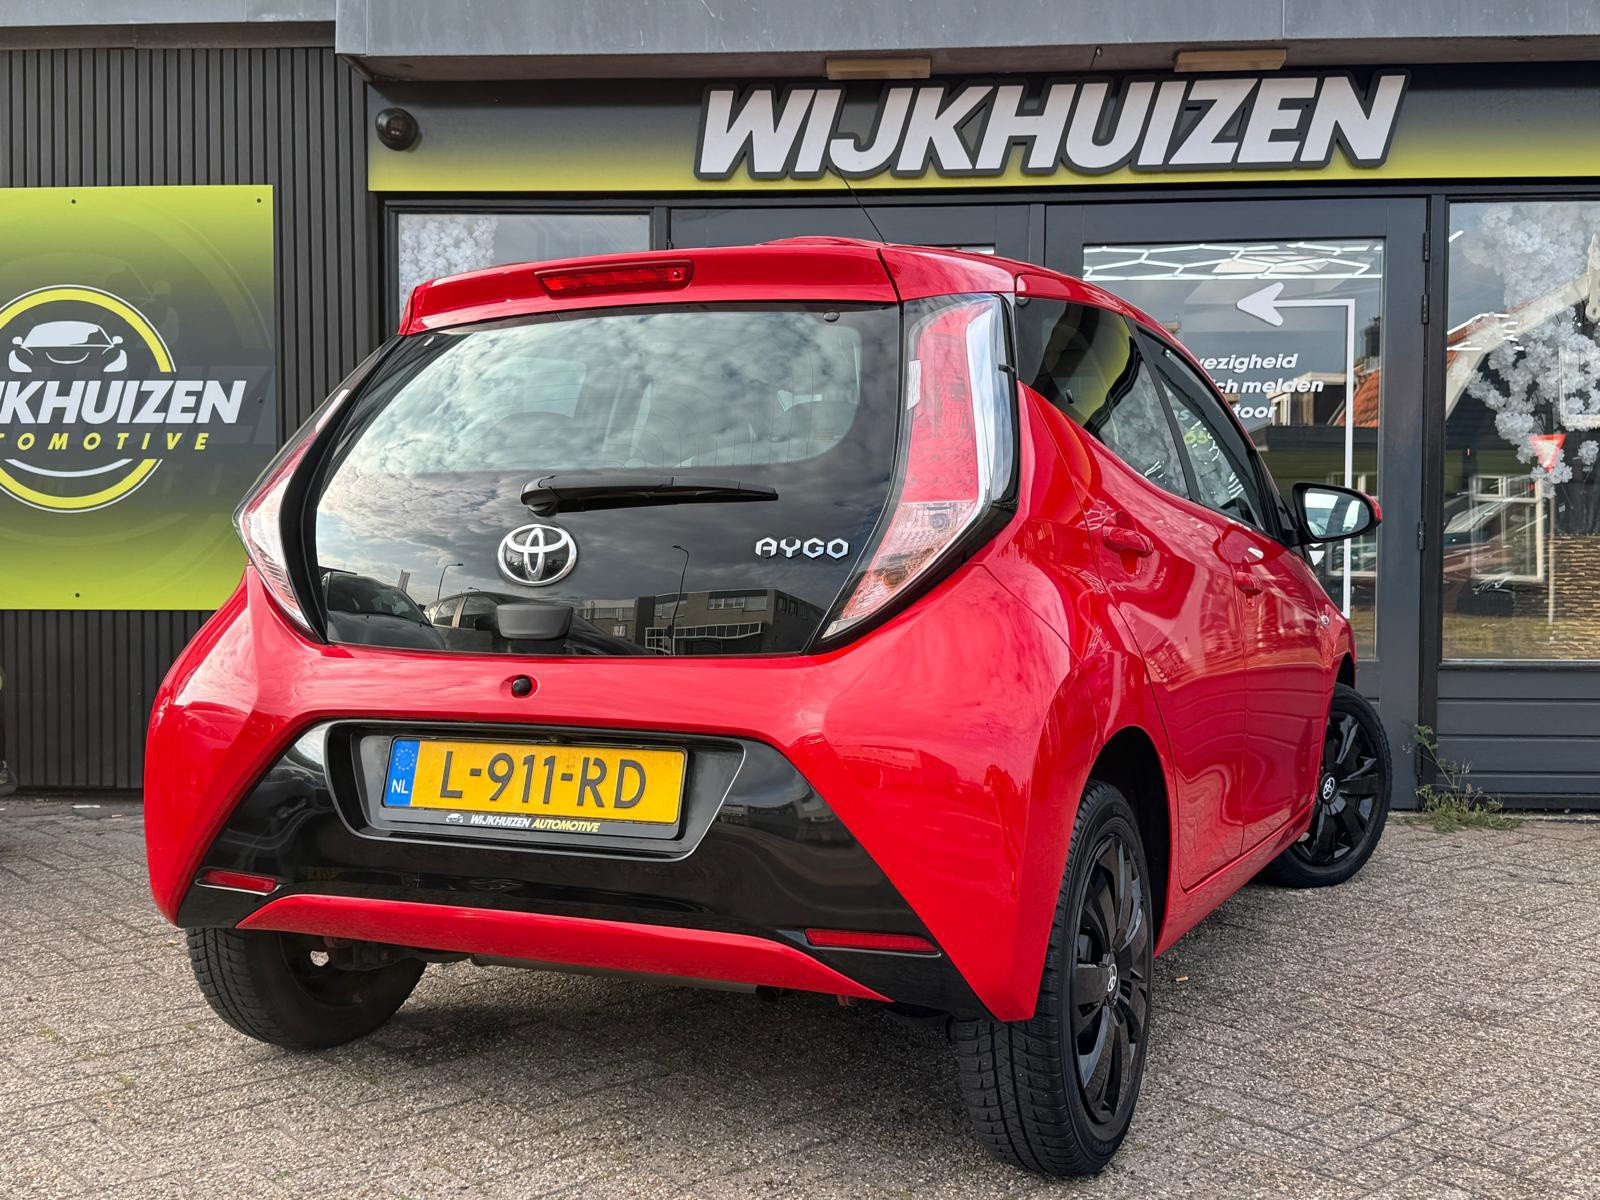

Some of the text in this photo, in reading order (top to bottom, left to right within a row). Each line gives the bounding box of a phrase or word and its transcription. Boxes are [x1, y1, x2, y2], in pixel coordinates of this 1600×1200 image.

[698, 74, 1406, 175] WIJKHUIZEN
[1214, 378, 1324, 394] ch melden
[0, 380, 247, 424] KHUIZEN
[1232, 403, 1278, 419] toor
[755, 537, 849, 559] AYGO
[391, 750, 647, 810] NL L-911-RD
[470, 814, 600, 833] WIJKHUIZEN AUTOMOTIVE
